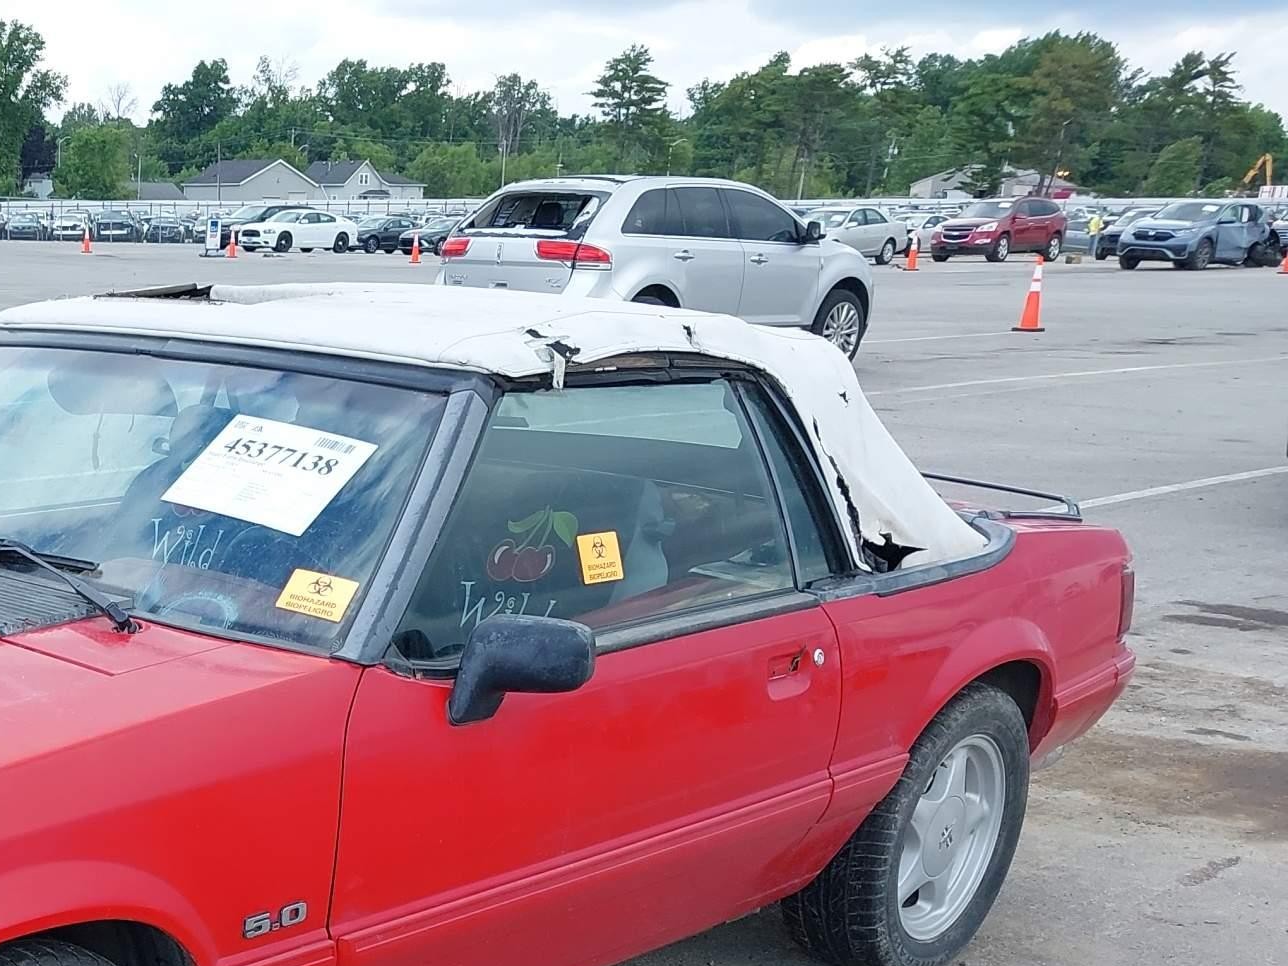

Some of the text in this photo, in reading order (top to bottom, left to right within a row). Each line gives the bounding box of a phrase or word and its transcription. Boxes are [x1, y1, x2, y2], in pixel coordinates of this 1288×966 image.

[224, 437, 339, 476] 45377138
[152, 518, 224, 570] Wild
[289, 593, 337, 609] BIOHAZARD
[244, 900, 308, 939] 5.0
